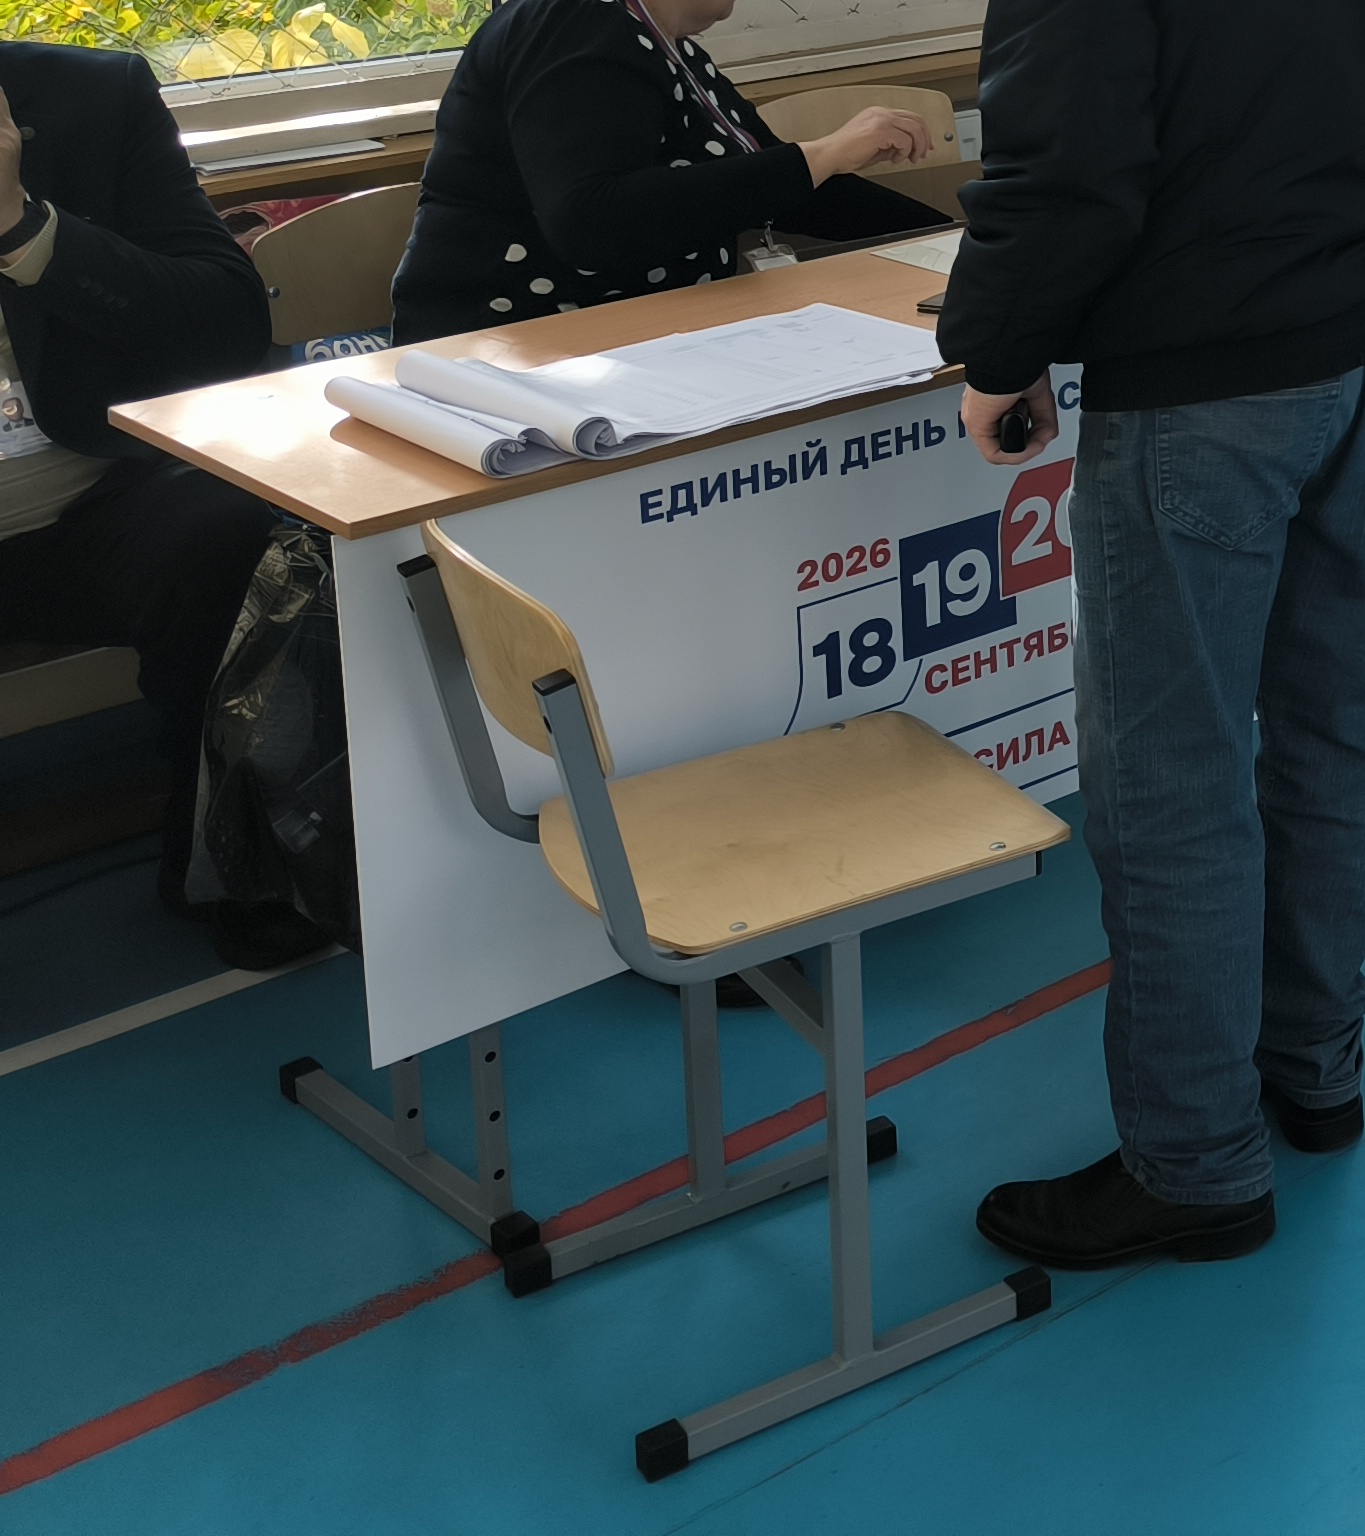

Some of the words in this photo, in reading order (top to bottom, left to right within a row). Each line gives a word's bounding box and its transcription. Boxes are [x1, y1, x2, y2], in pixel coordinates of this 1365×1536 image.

[639, 438, 829, 525] ЕДИНЫЙ
[840, 418, 947, 476] ДЕНЬ
[796, 537, 892, 593] 2026
[812, 617, 897, 700] 18
[912, 548, 992, 628] 19
[924, 618, 1074, 695] СЕНТЯБ
